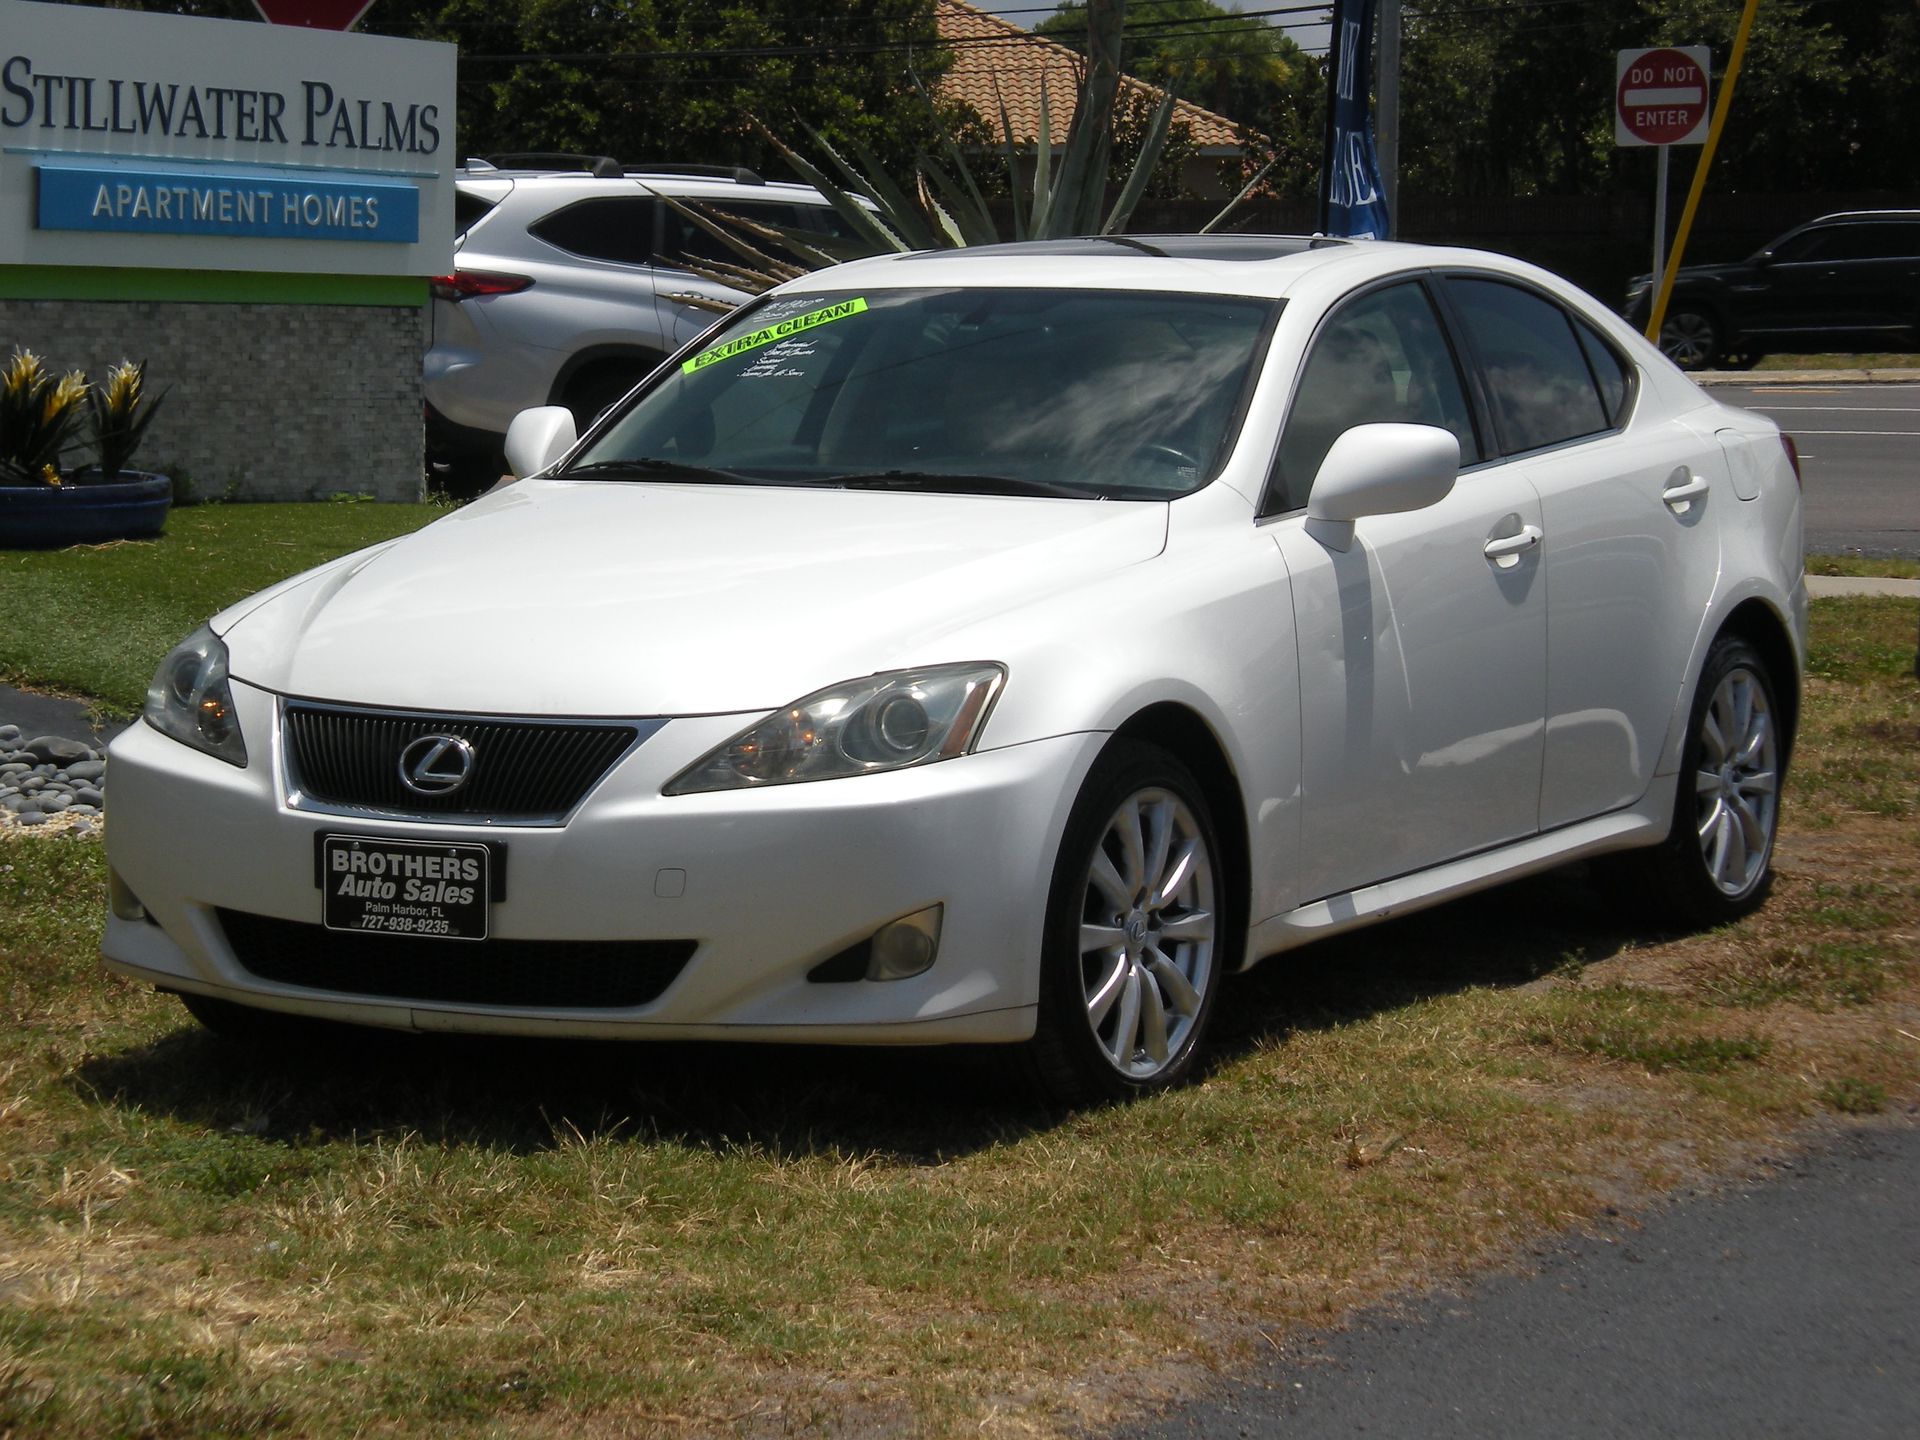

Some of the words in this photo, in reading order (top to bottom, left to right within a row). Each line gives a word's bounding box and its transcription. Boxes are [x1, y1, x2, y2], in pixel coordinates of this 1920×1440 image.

[1631, 68, 1654, 84] DO
[1663, 67, 1696, 82] NOT
[2, 56, 289, 144] STILLWATER
[301, 80, 440, 155] PALMS
[1636, 110, 1688, 127] ENTER
[93, 184, 274, 223] APARTMENT
[283, 193, 379, 229] HOMES
[694, 328, 774, 368] EXTRA
[776, 302, 855, 335] CLEAN
[332, 849, 479, 882] BROTHERS
[337, 874, 396, 900] Auto
[403, 878, 475, 905] Sales
[361, 914, 449, 934] 727-938-9235
[365, 902, 390, 914] Palm
[392, 904, 429, 917] Harbor,
[431, 906, 444, 917] FL
